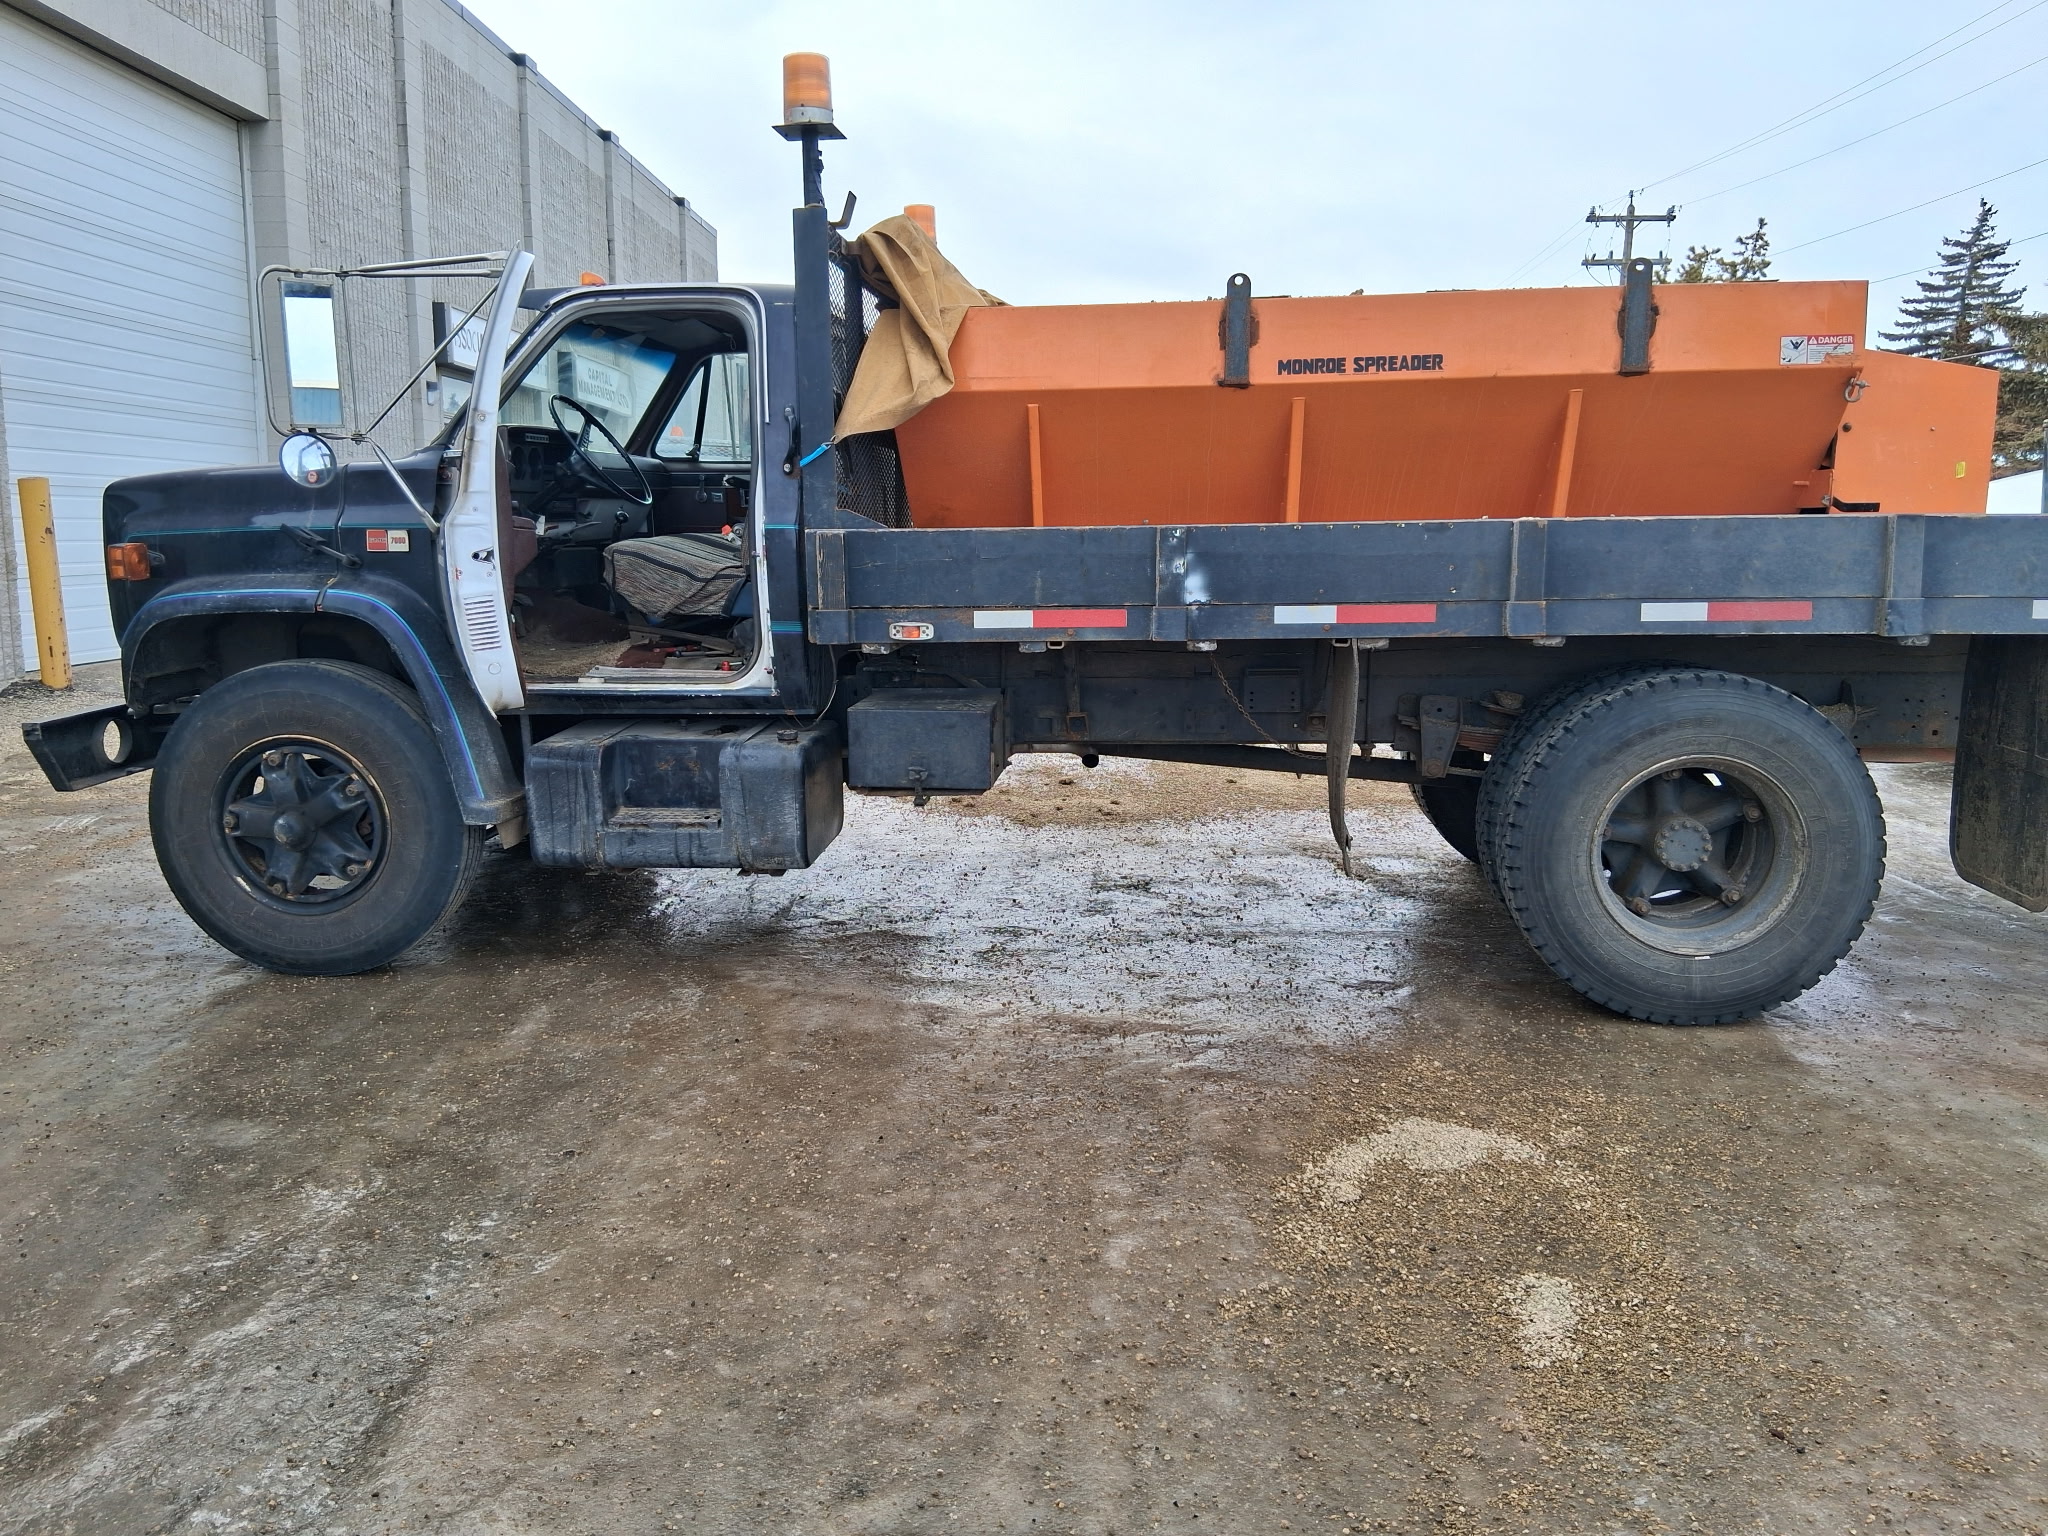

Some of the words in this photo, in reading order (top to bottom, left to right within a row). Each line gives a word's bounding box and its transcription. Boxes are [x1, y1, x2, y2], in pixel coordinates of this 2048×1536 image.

[1818, 335, 1854, 344] DANGER
[1277, 357, 1347, 376] MONROE
[1353, 353, 1444, 373] SPREADER
[587, 367, 613, 387] CAPITAL
[578, 378, 615, 402] MANAGEMENT
[617, 393, 629, 408] LTD
[390, 536, 407, 545] 7000
